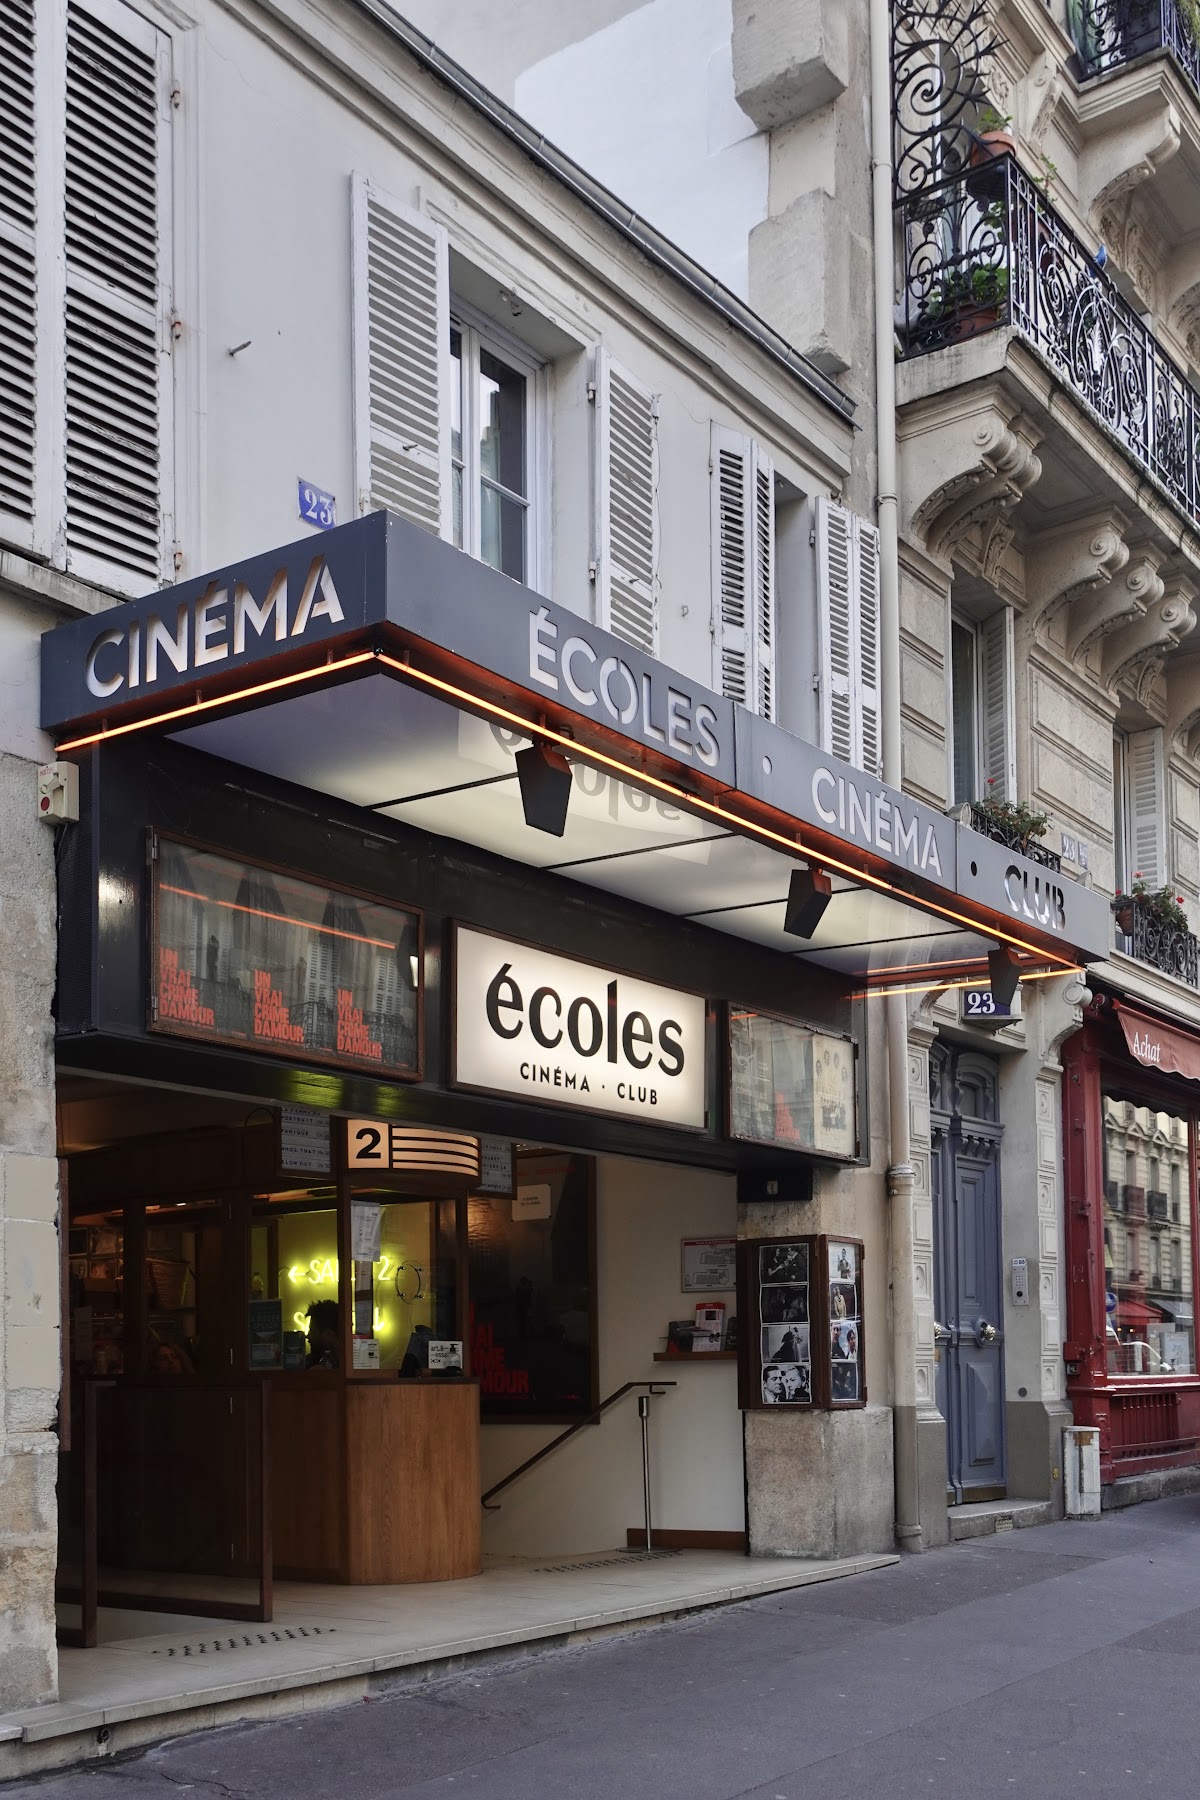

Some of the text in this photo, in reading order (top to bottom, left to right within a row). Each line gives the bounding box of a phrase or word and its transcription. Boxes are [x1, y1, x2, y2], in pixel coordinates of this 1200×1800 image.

[304, 489, 332, 525] 23
[86, 554, 345, 698] CINÉMA
[529, 606, 1066, 931] ÉCOLES CINÉMA CLUB
[1063, 835, 1075, 861] 23
[160, 947, 178, 969] UN
[160, 964, 191, 988] VRAI
[254, 970, 271, 988] UN
[160, 982, 199, 1006] CRIME
[255, 986, 283, 1008] VRAI
[337, 989, 353, 1008] UN
[967, 992, 996, 1014] 23
[254, 1002, 290, 1024] CRIME
[337, 1004, 363, 1025] VRAI
[485, 963, 685, 1077] écoles
[337, 1019, 369, 1041] CRIME
[1133, 1032, 1161, 1063] Achat
[520, 1062, 658, 1106] CINÉMA CLUB
[355, 1127, 382, 1160] 2
[376, 1255, 391, 1281] 2
